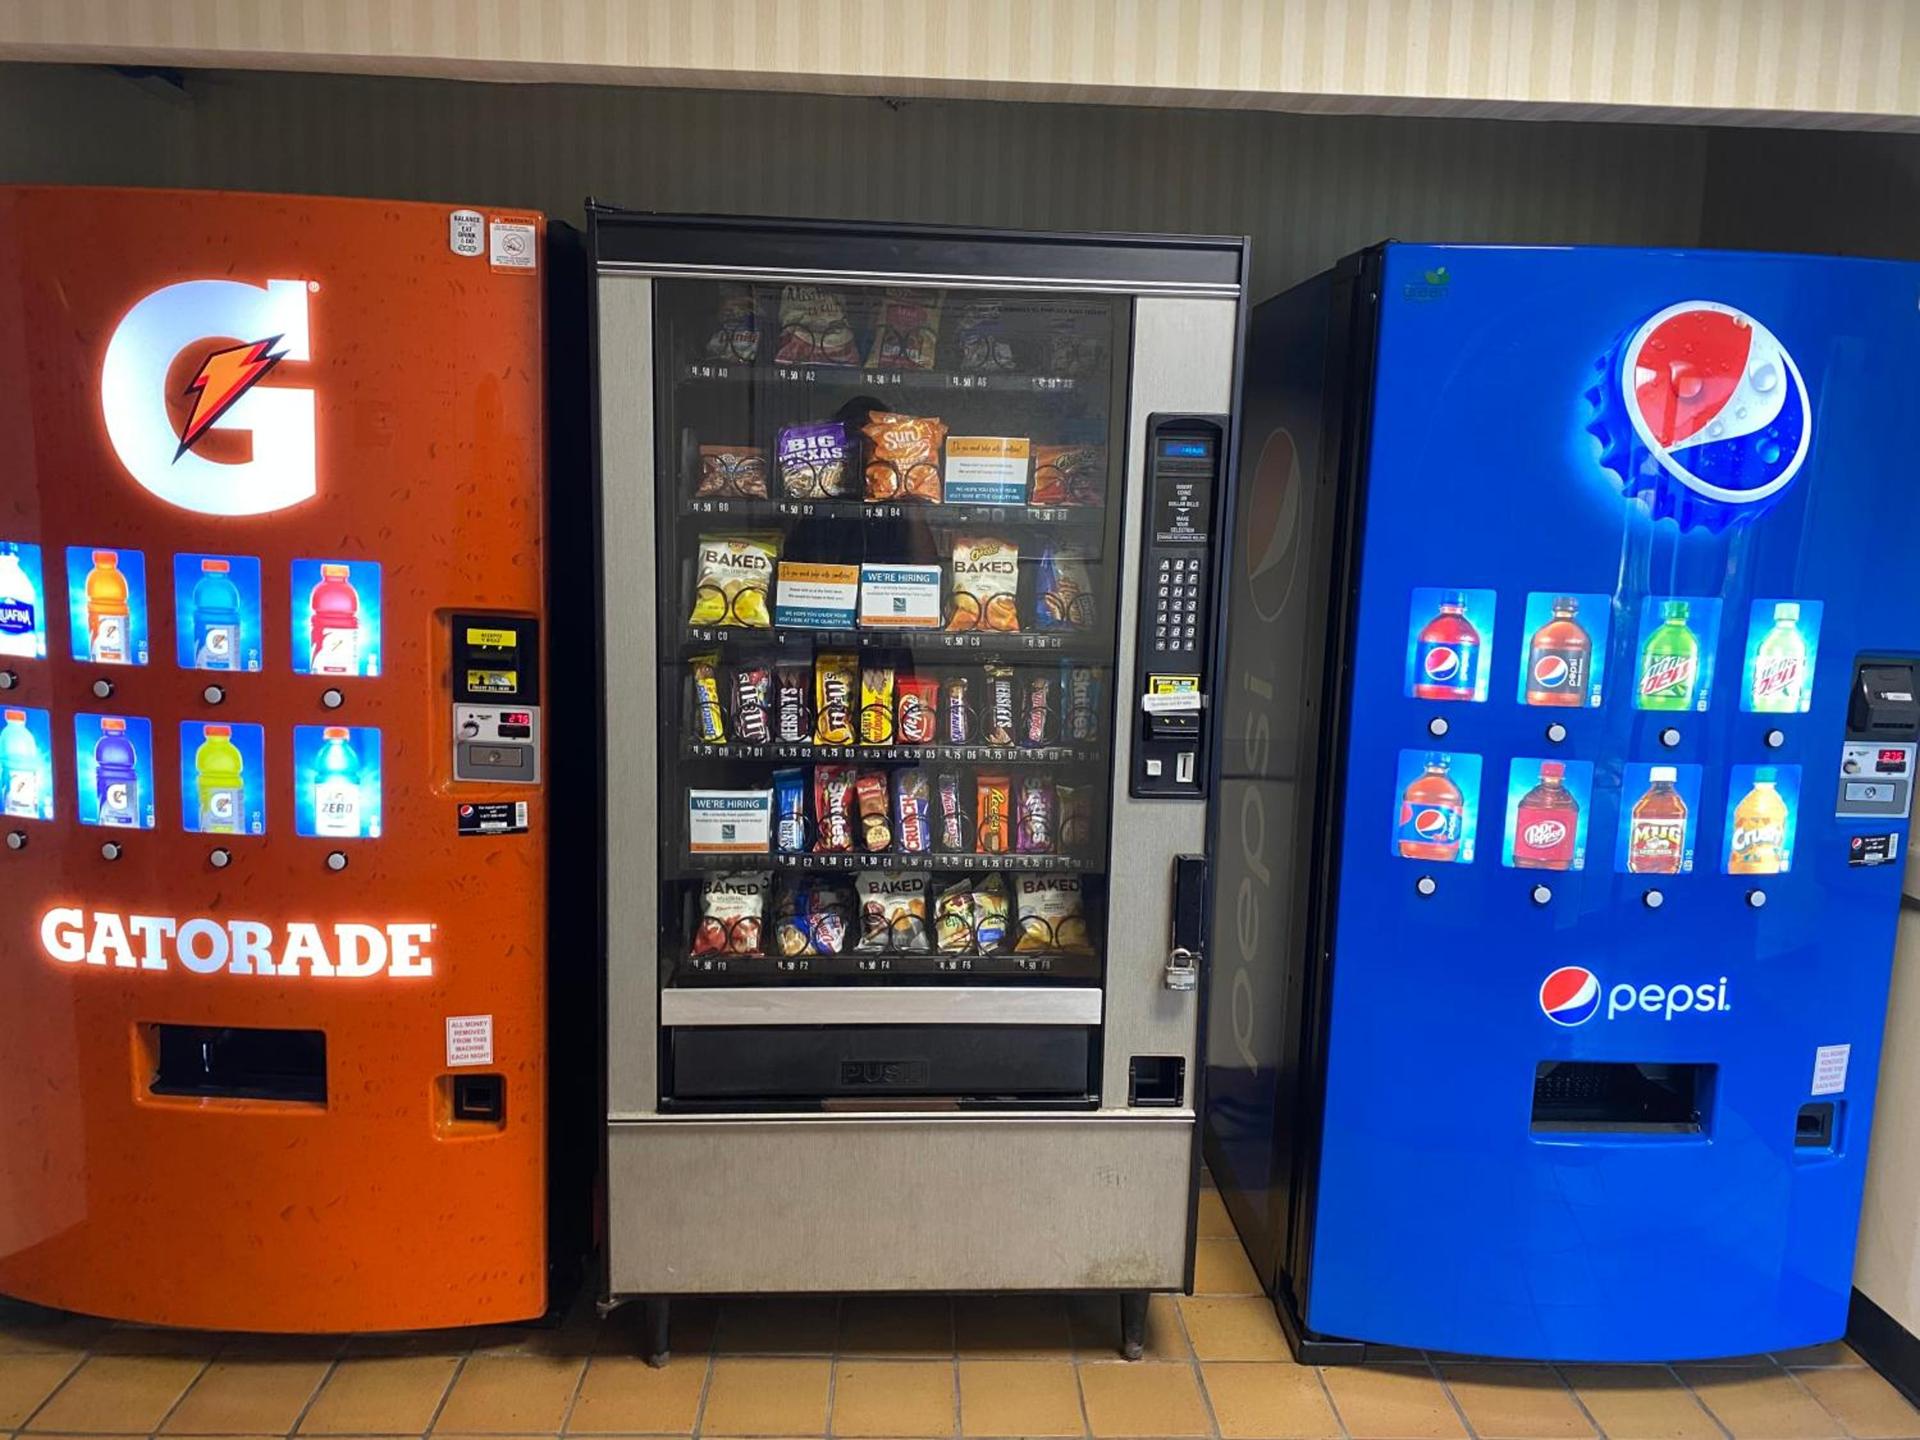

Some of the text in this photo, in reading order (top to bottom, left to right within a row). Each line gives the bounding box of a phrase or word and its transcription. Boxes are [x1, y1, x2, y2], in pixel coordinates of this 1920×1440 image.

[101, 279, 317, 516] G
[787, 435, 835, 452] BIG
[706, 550, 766, 570] BAKED
[955, 561, 1014, 574] BAKED
[867, 572, 930, 583] WE'RE HIRING
[1568, 658, 1577, 687] pepsi
[1072, 669, 1090, 739] Skittles
[322, 803, 353, 813] ZERO
[696, 799, 760, 809] WE'RE HIRING
[828, 782, 847, 847] Skittles
[900, 794, 921, 850] CRUNCH
[1529, 826, 1564, 845] Pepper
[1634, 825, 1682, 843] MUG
[1732, 826, 1782, 850] Crush
[704, 879, 759, 895] BAKED
[869, 878, 924, 894] BAKED
[1023, 878, 1079, 894] BAKED
[40, 907, 433, 977] GATORADE
[1608, 976, 1728, 1021] pepsi
[465, 1020, 488, 1028] MONEY
